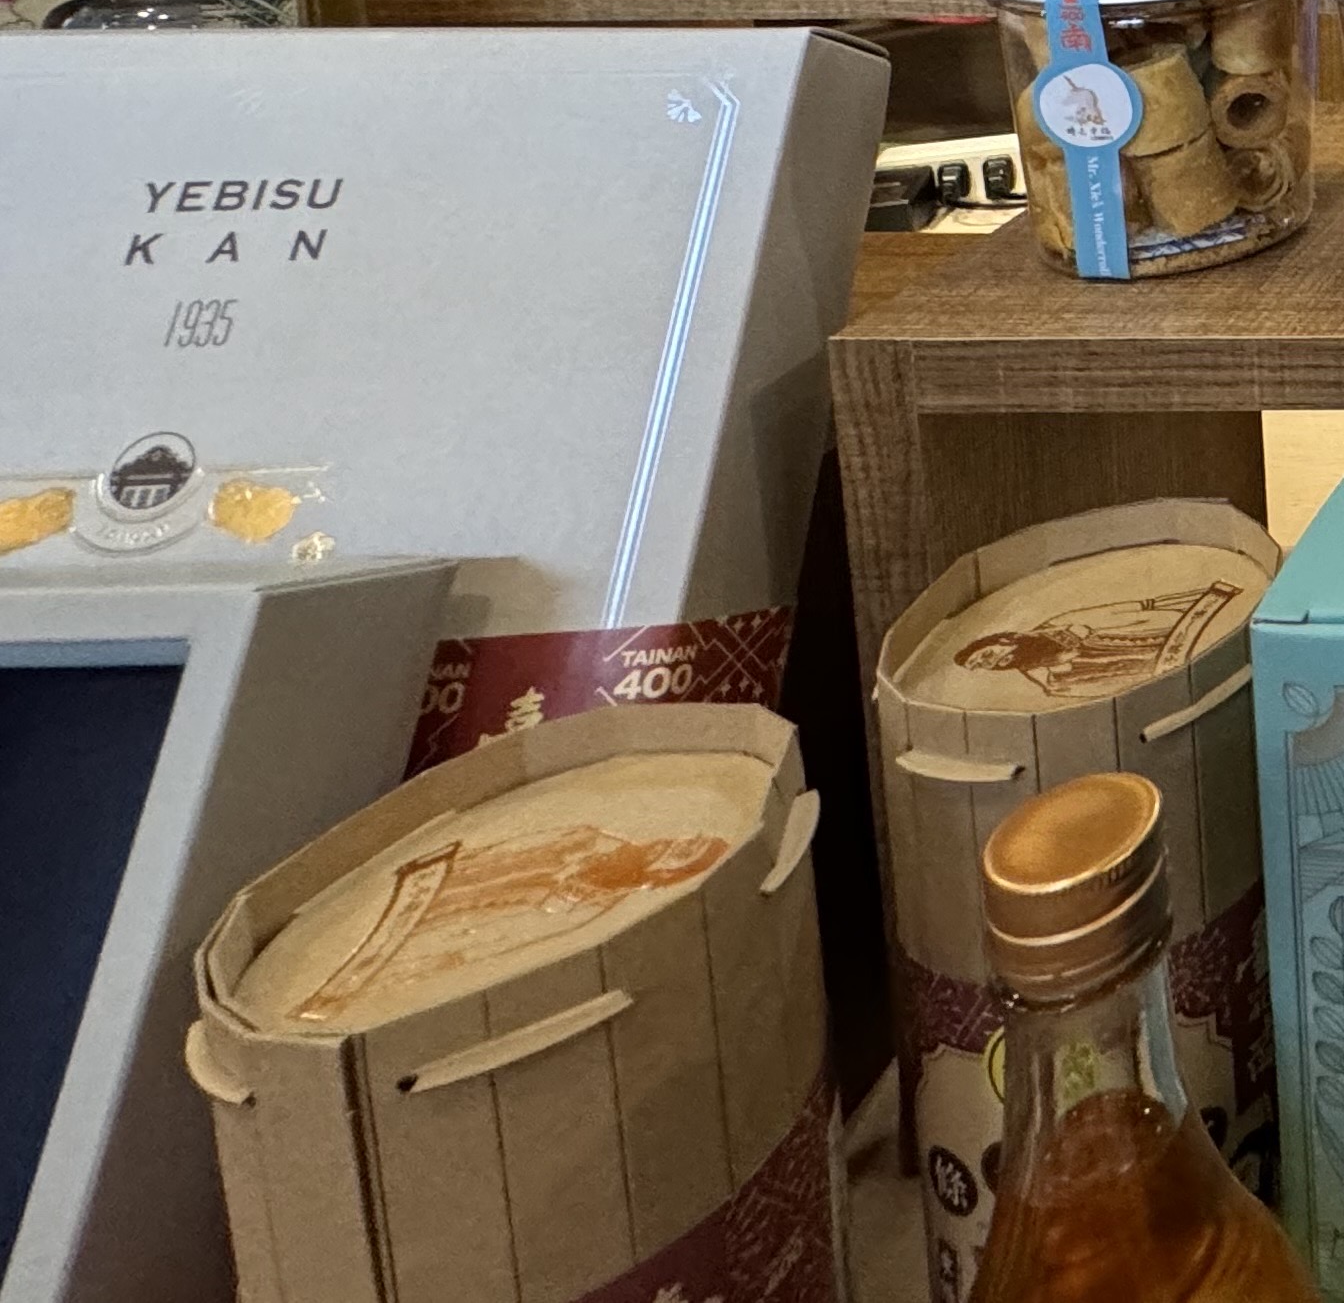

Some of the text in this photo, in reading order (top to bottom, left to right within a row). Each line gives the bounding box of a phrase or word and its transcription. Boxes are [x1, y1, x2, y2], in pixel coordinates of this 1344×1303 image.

[144, 178, 344, 212] YEBISU
[164, 299, 239, 348] 1935
[620, 645, 697, 667] TAINAN
[613, 664, 694, 700] 400
